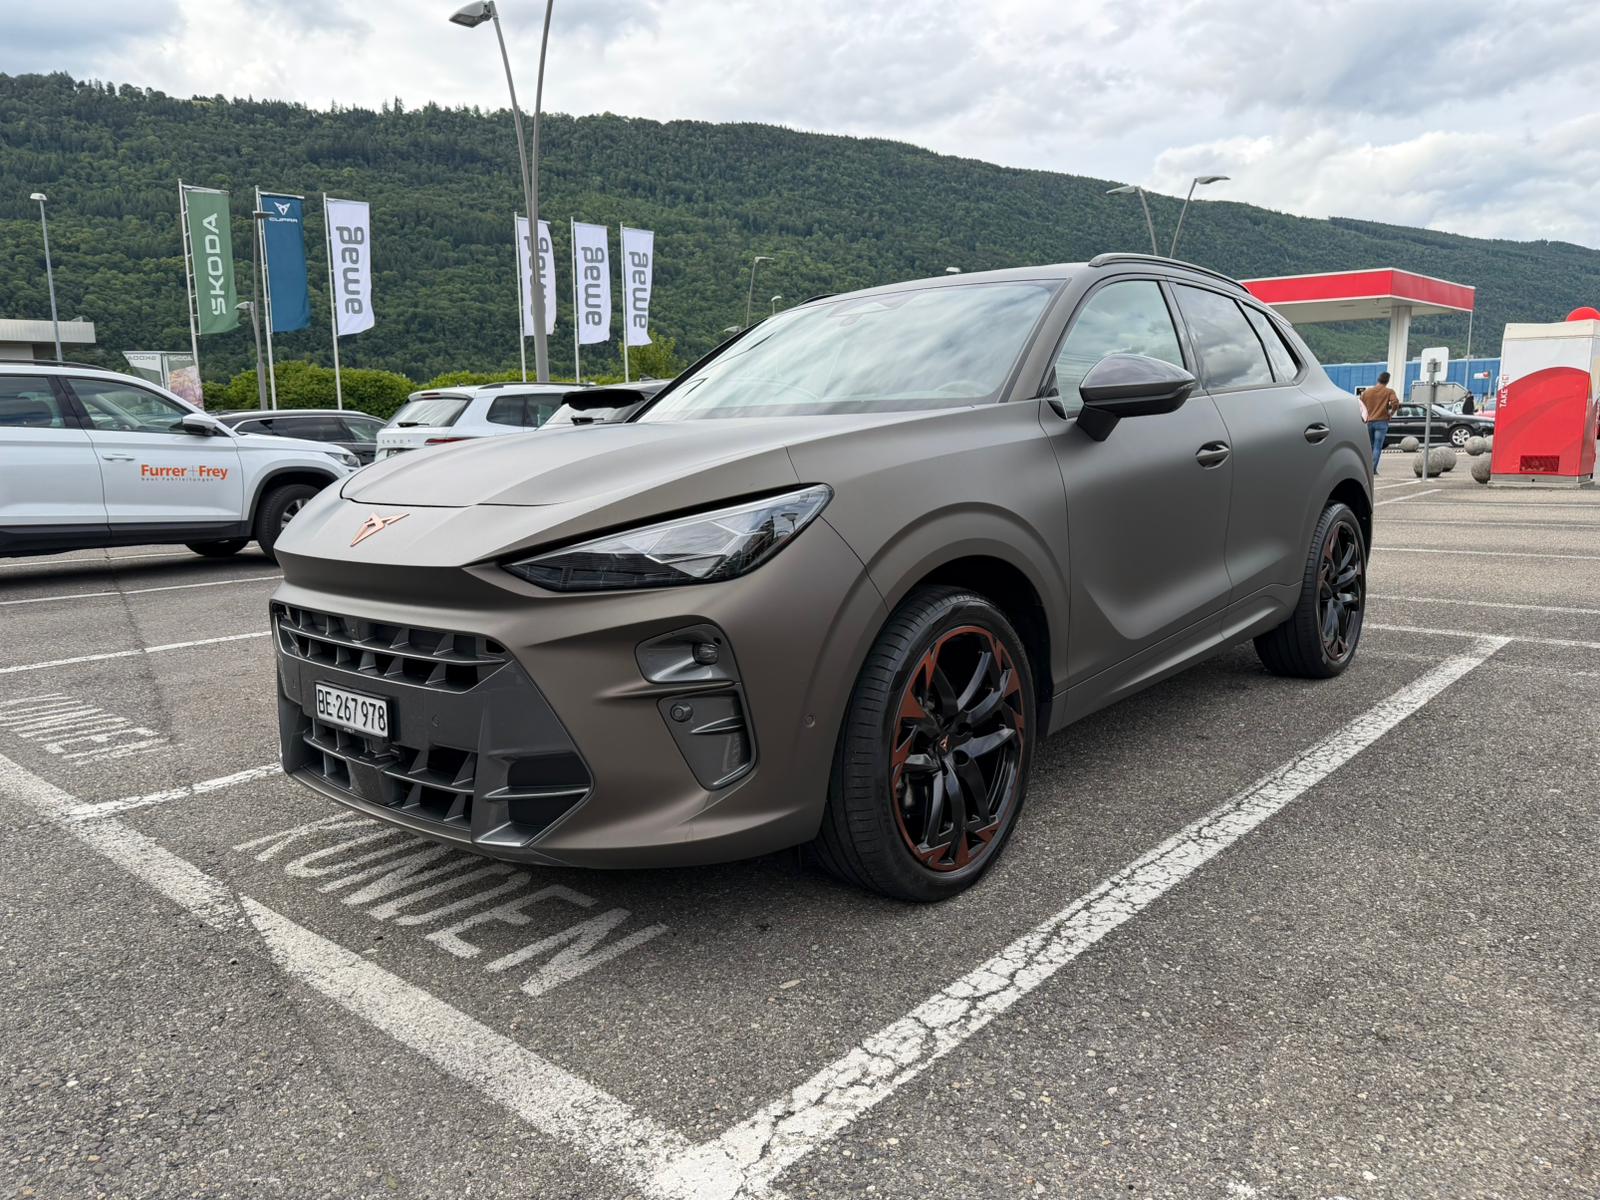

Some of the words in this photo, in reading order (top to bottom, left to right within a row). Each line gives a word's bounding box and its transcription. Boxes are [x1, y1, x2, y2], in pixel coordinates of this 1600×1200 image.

[336, 226, 364, 314] amag
[581, 246, 605, 326] amag
[629, 251, 649, 329] amag
[1499, 388, 1508, 408] TAKE
[233, 810, 670, 998] KUNDEN
